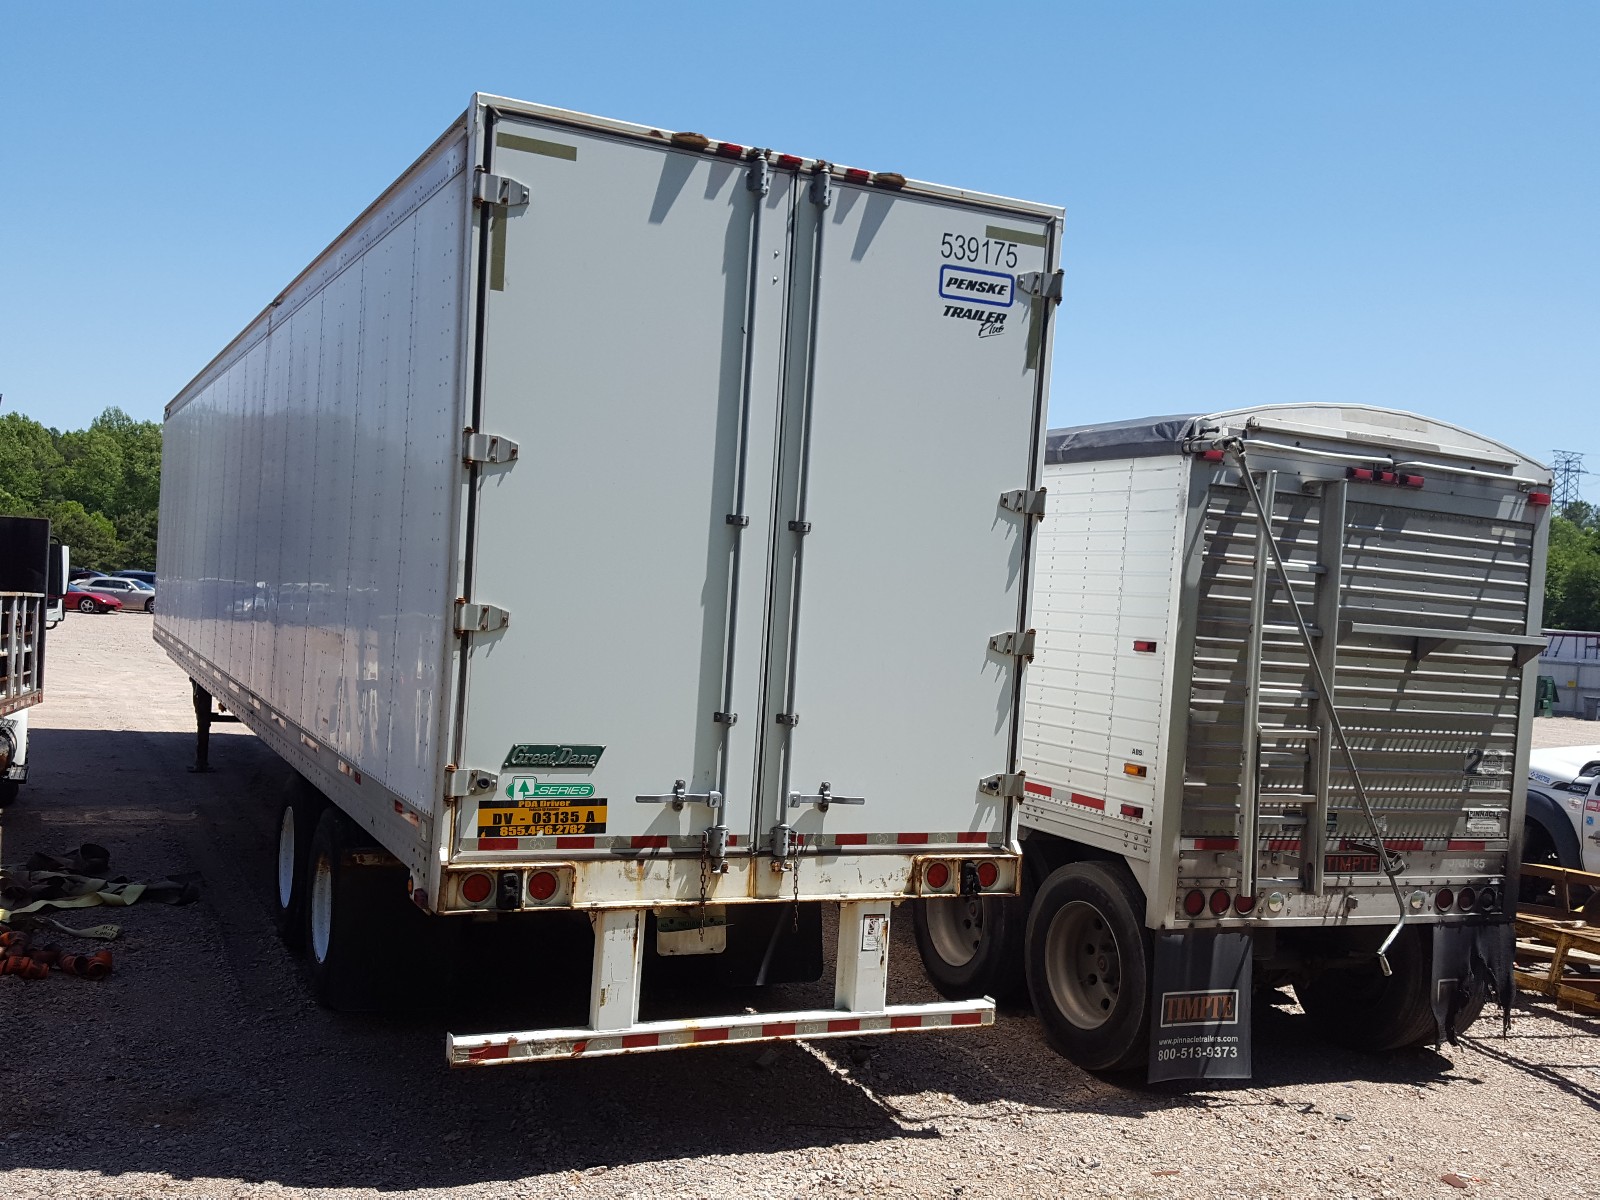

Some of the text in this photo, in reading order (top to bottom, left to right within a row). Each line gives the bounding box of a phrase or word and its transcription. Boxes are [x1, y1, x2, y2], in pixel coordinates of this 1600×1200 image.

[941, 232, 1018, 269] 539175
[945, 276, 1009, 296] PENSKE
[943, 305, 1008, 324] TRAILER
[978, 320, 1005, 338] Plus
[511, 745, 598, 766] Great Dane
[518, 799, 571, 808] PDA Driver
[492, 812, 514, 825] DV
[531, 811, 580, 824] 03135
[585, 810, 596, 823] A
[499, 824, 586, 837] 855.456.2782
[1326, 856, 1379, 871] TIMPTE
[1165, 994, 1235, 1021] TIMPTE
[1158, 1035, 1239, 1046] www.pinnacletrailers.com
[1157, 1046, 1238, 1062] 800-513-9373
